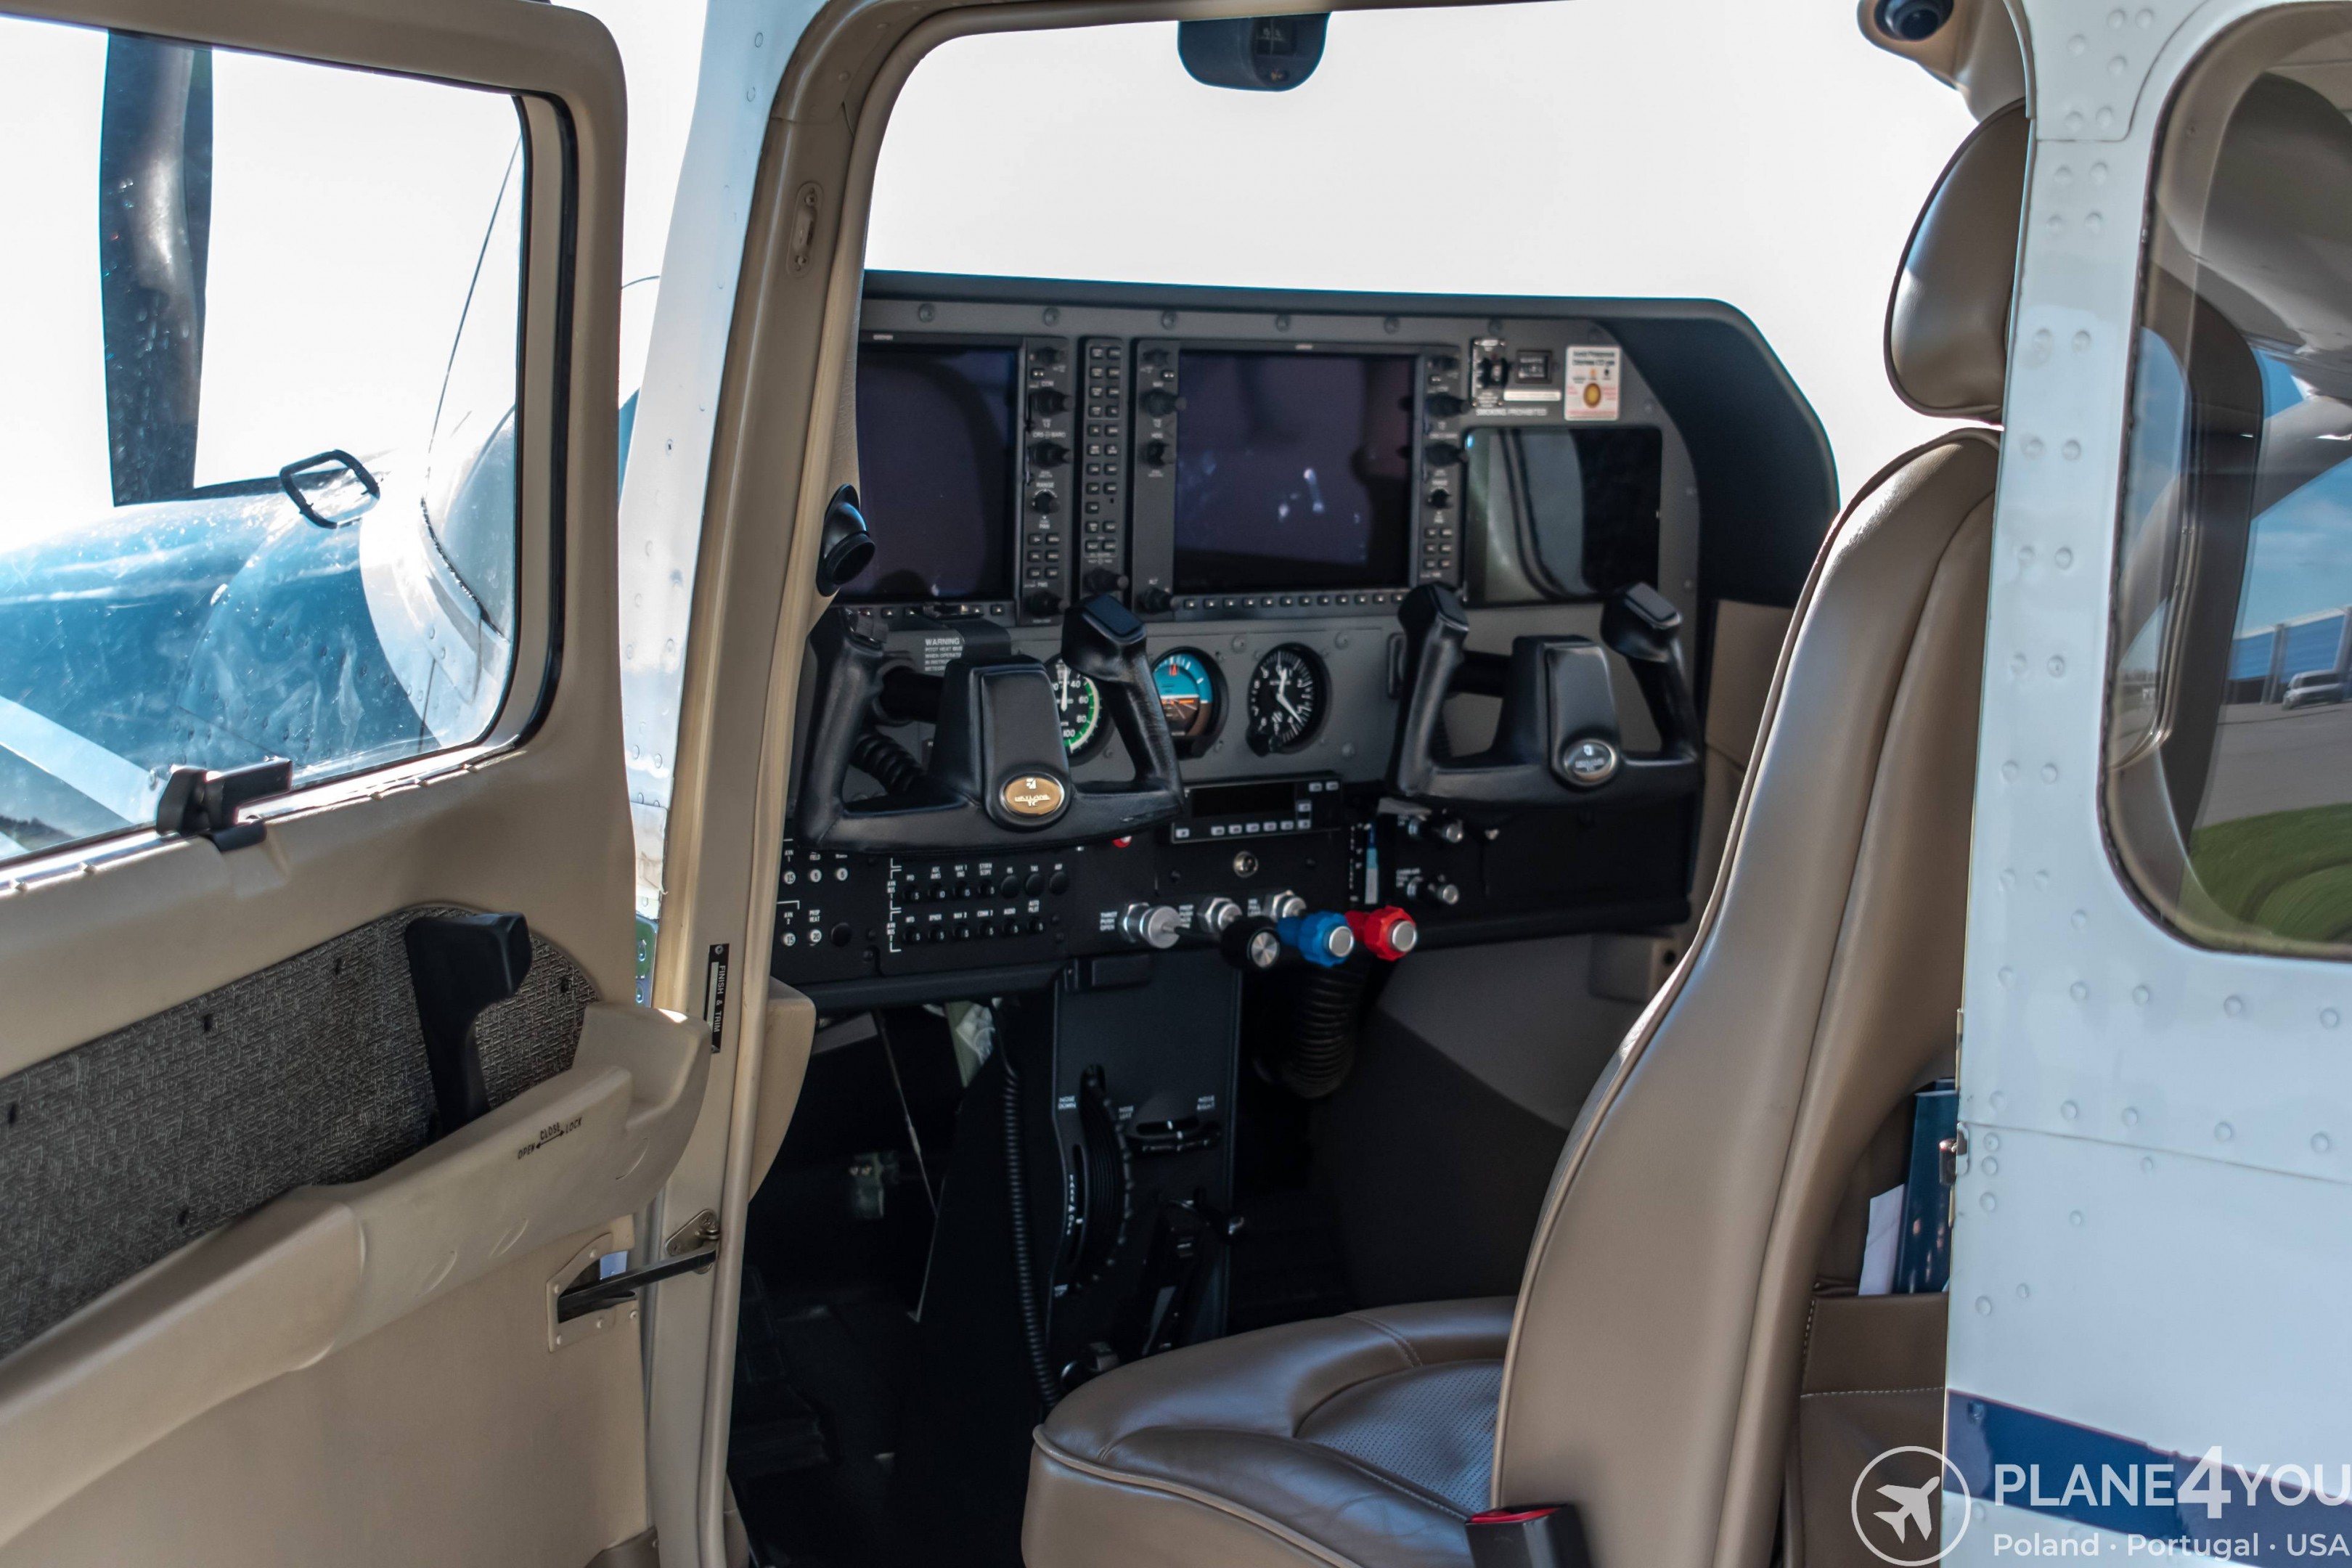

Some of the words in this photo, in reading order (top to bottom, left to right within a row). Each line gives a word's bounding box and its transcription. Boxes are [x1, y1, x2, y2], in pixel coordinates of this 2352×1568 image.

[1079, 695, 1089, 704] 60
[965, 929, 969, 938] 5
[717, 965, 726, 995] FINISH
[714, 1010, 722, 1032] TRIM
[540, 1122, 560, 1140] CLOSE
[565, 1116, 582, 1134] LOCK
[518, 1143, 536, 1159] OPEN
